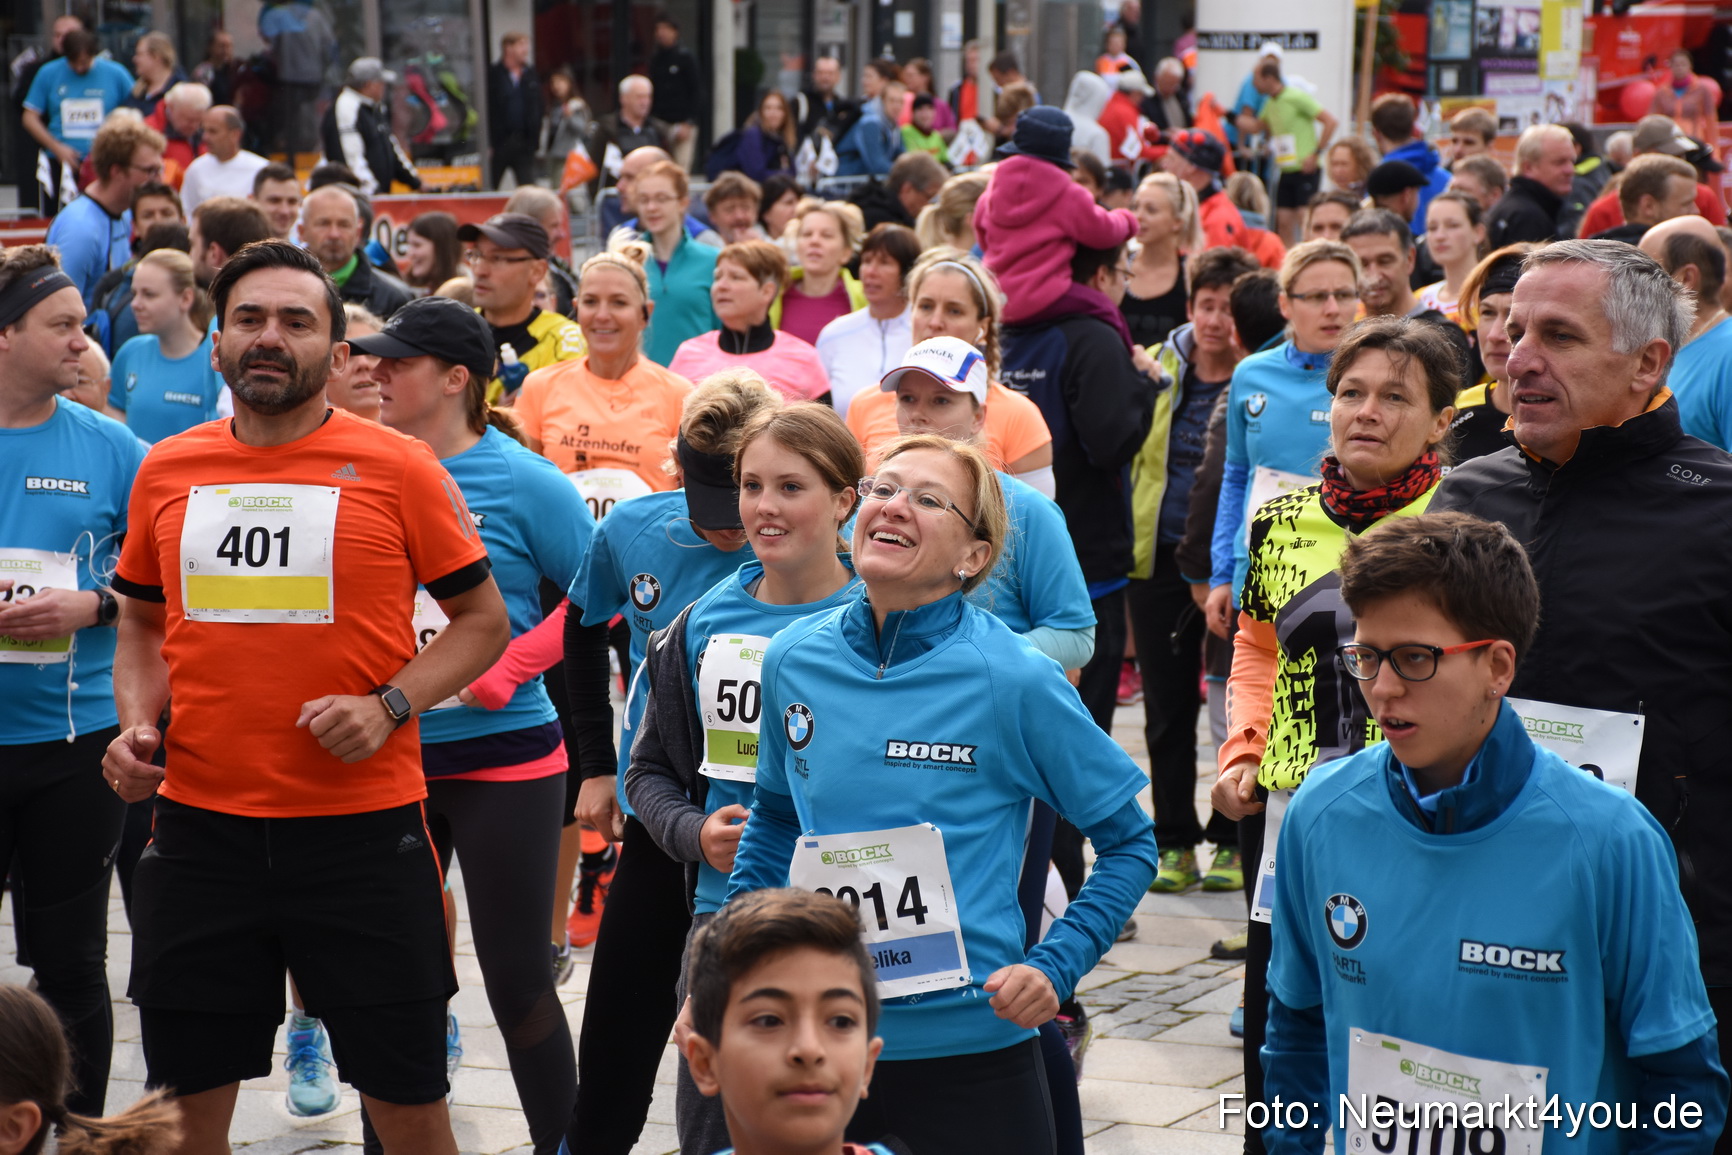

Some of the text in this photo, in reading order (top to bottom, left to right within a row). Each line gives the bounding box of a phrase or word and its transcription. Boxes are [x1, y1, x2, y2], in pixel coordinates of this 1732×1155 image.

[560, 435, 641, 455] Atzenhofer
[331, 473, 361, 482] adidas
[1671, 464, 1712, 485] GORE
[26, 476, 90, 494] BOCK
[242, 497, 293, 508] BOCK
[217, 526, 290, 568] 401
[188, 561, 195, 569] D
[717, 679, 762, 724] 50
[707, 714, 713, 723] S
[1524, 717, 1584, 739] BOCK
[737, 739, 759, 756] Luci
[886, 739, 978, 766] BOCK
[884, 760, 911, 769] inspired
[945, 765, 977, 774] concepts
[834, 844, 893, 864] BOCK
[873, 950, 912, 969] elika
[1460, 939, 1566, 973] BOCK
[1458, 965, 1568, 984] inspired by smart concepts
[1416, 1063, 1481, 1095] BOCK
